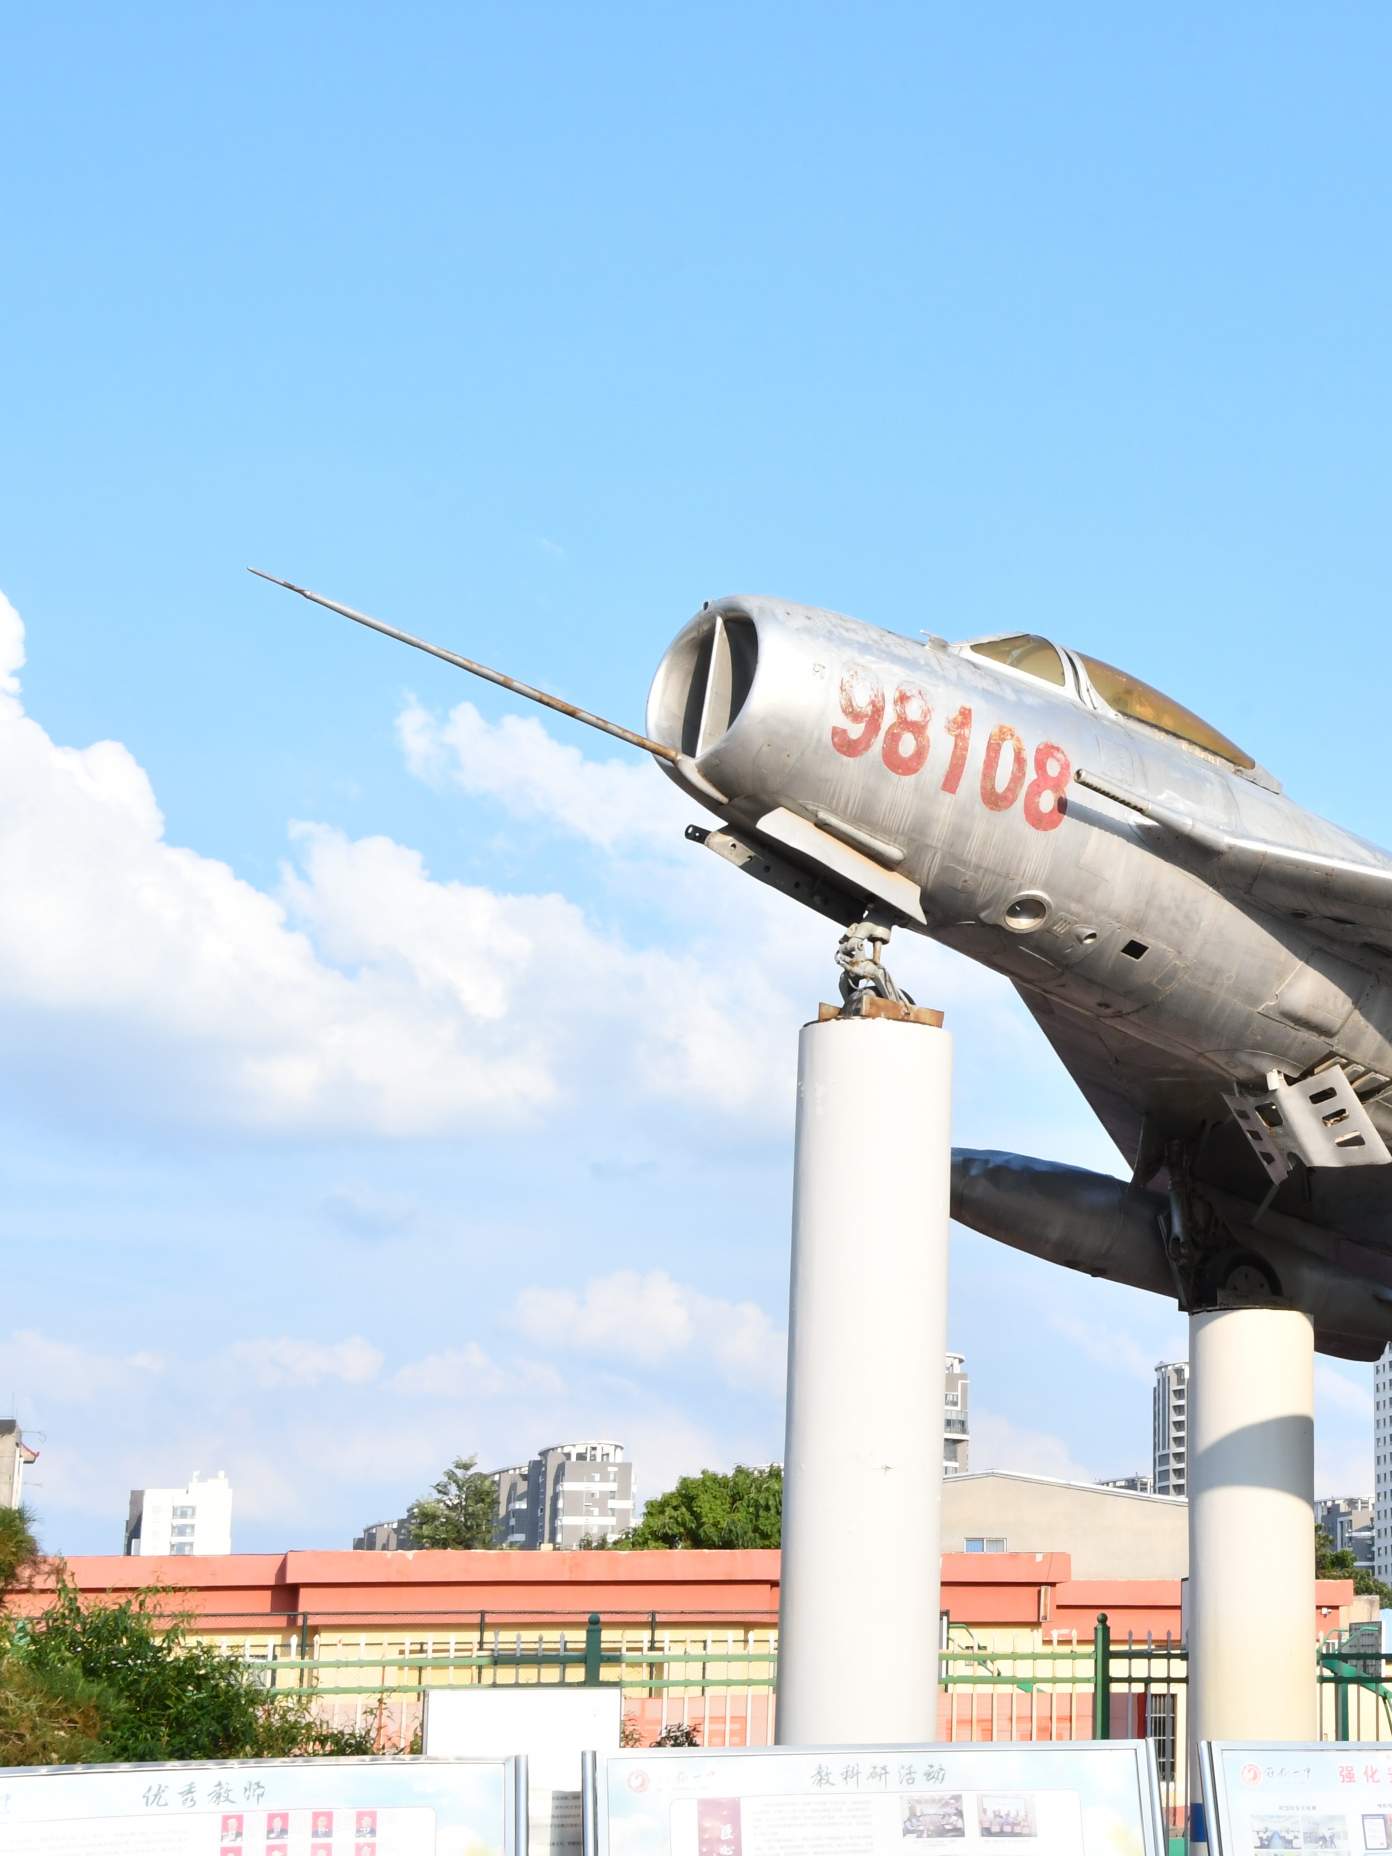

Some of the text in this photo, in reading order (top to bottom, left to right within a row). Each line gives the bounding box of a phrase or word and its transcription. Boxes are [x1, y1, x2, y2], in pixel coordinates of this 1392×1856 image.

[831, 666, 1071, 832] 98108
[811, 1764, 946, 1787] 教科研活动
[143, 1781, 265, 1808] 优秀教师
